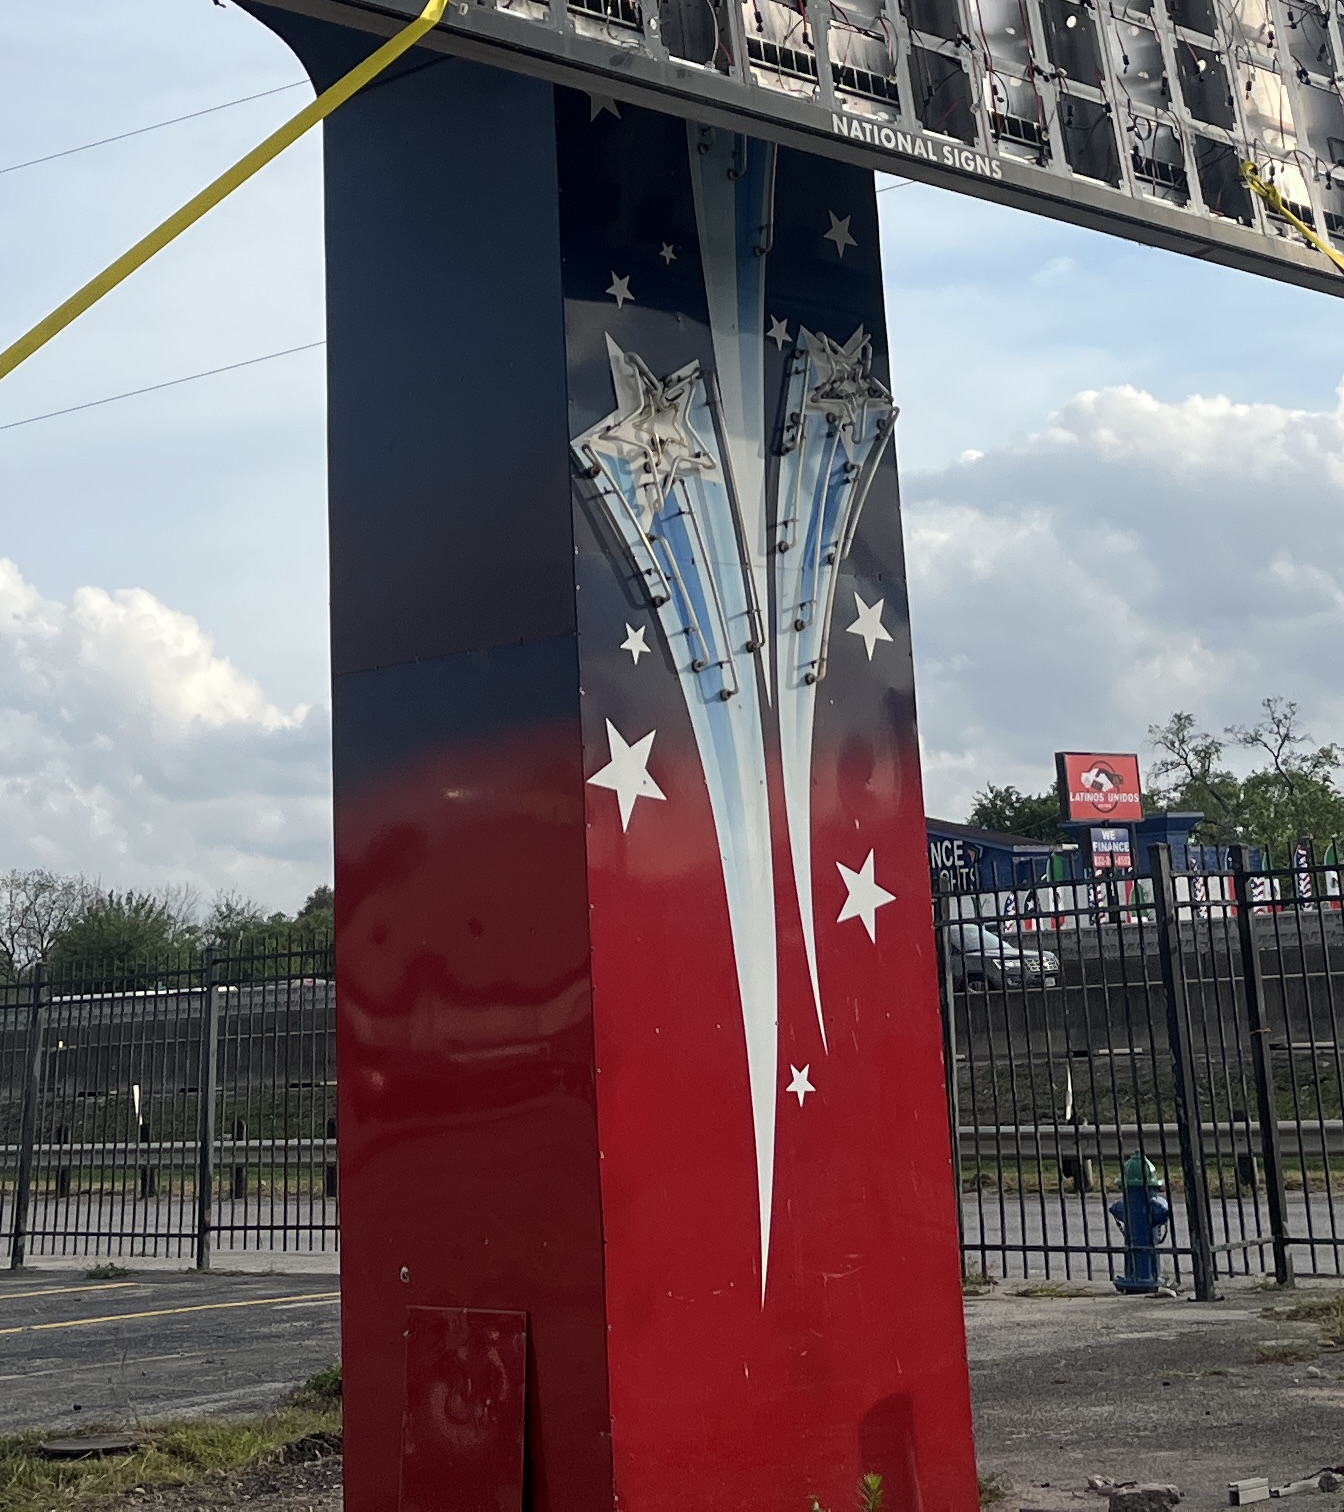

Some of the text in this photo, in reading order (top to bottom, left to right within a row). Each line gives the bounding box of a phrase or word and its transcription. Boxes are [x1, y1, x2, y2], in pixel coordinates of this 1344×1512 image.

[832, 113, 1003, 179] NATIONAL SIGNS
[1070, 792, 1139, 803] LATINOS UNIDOS
[1101, 830, 1116, 840] WE
[1092, 841, 1130, 853] FINANCE
